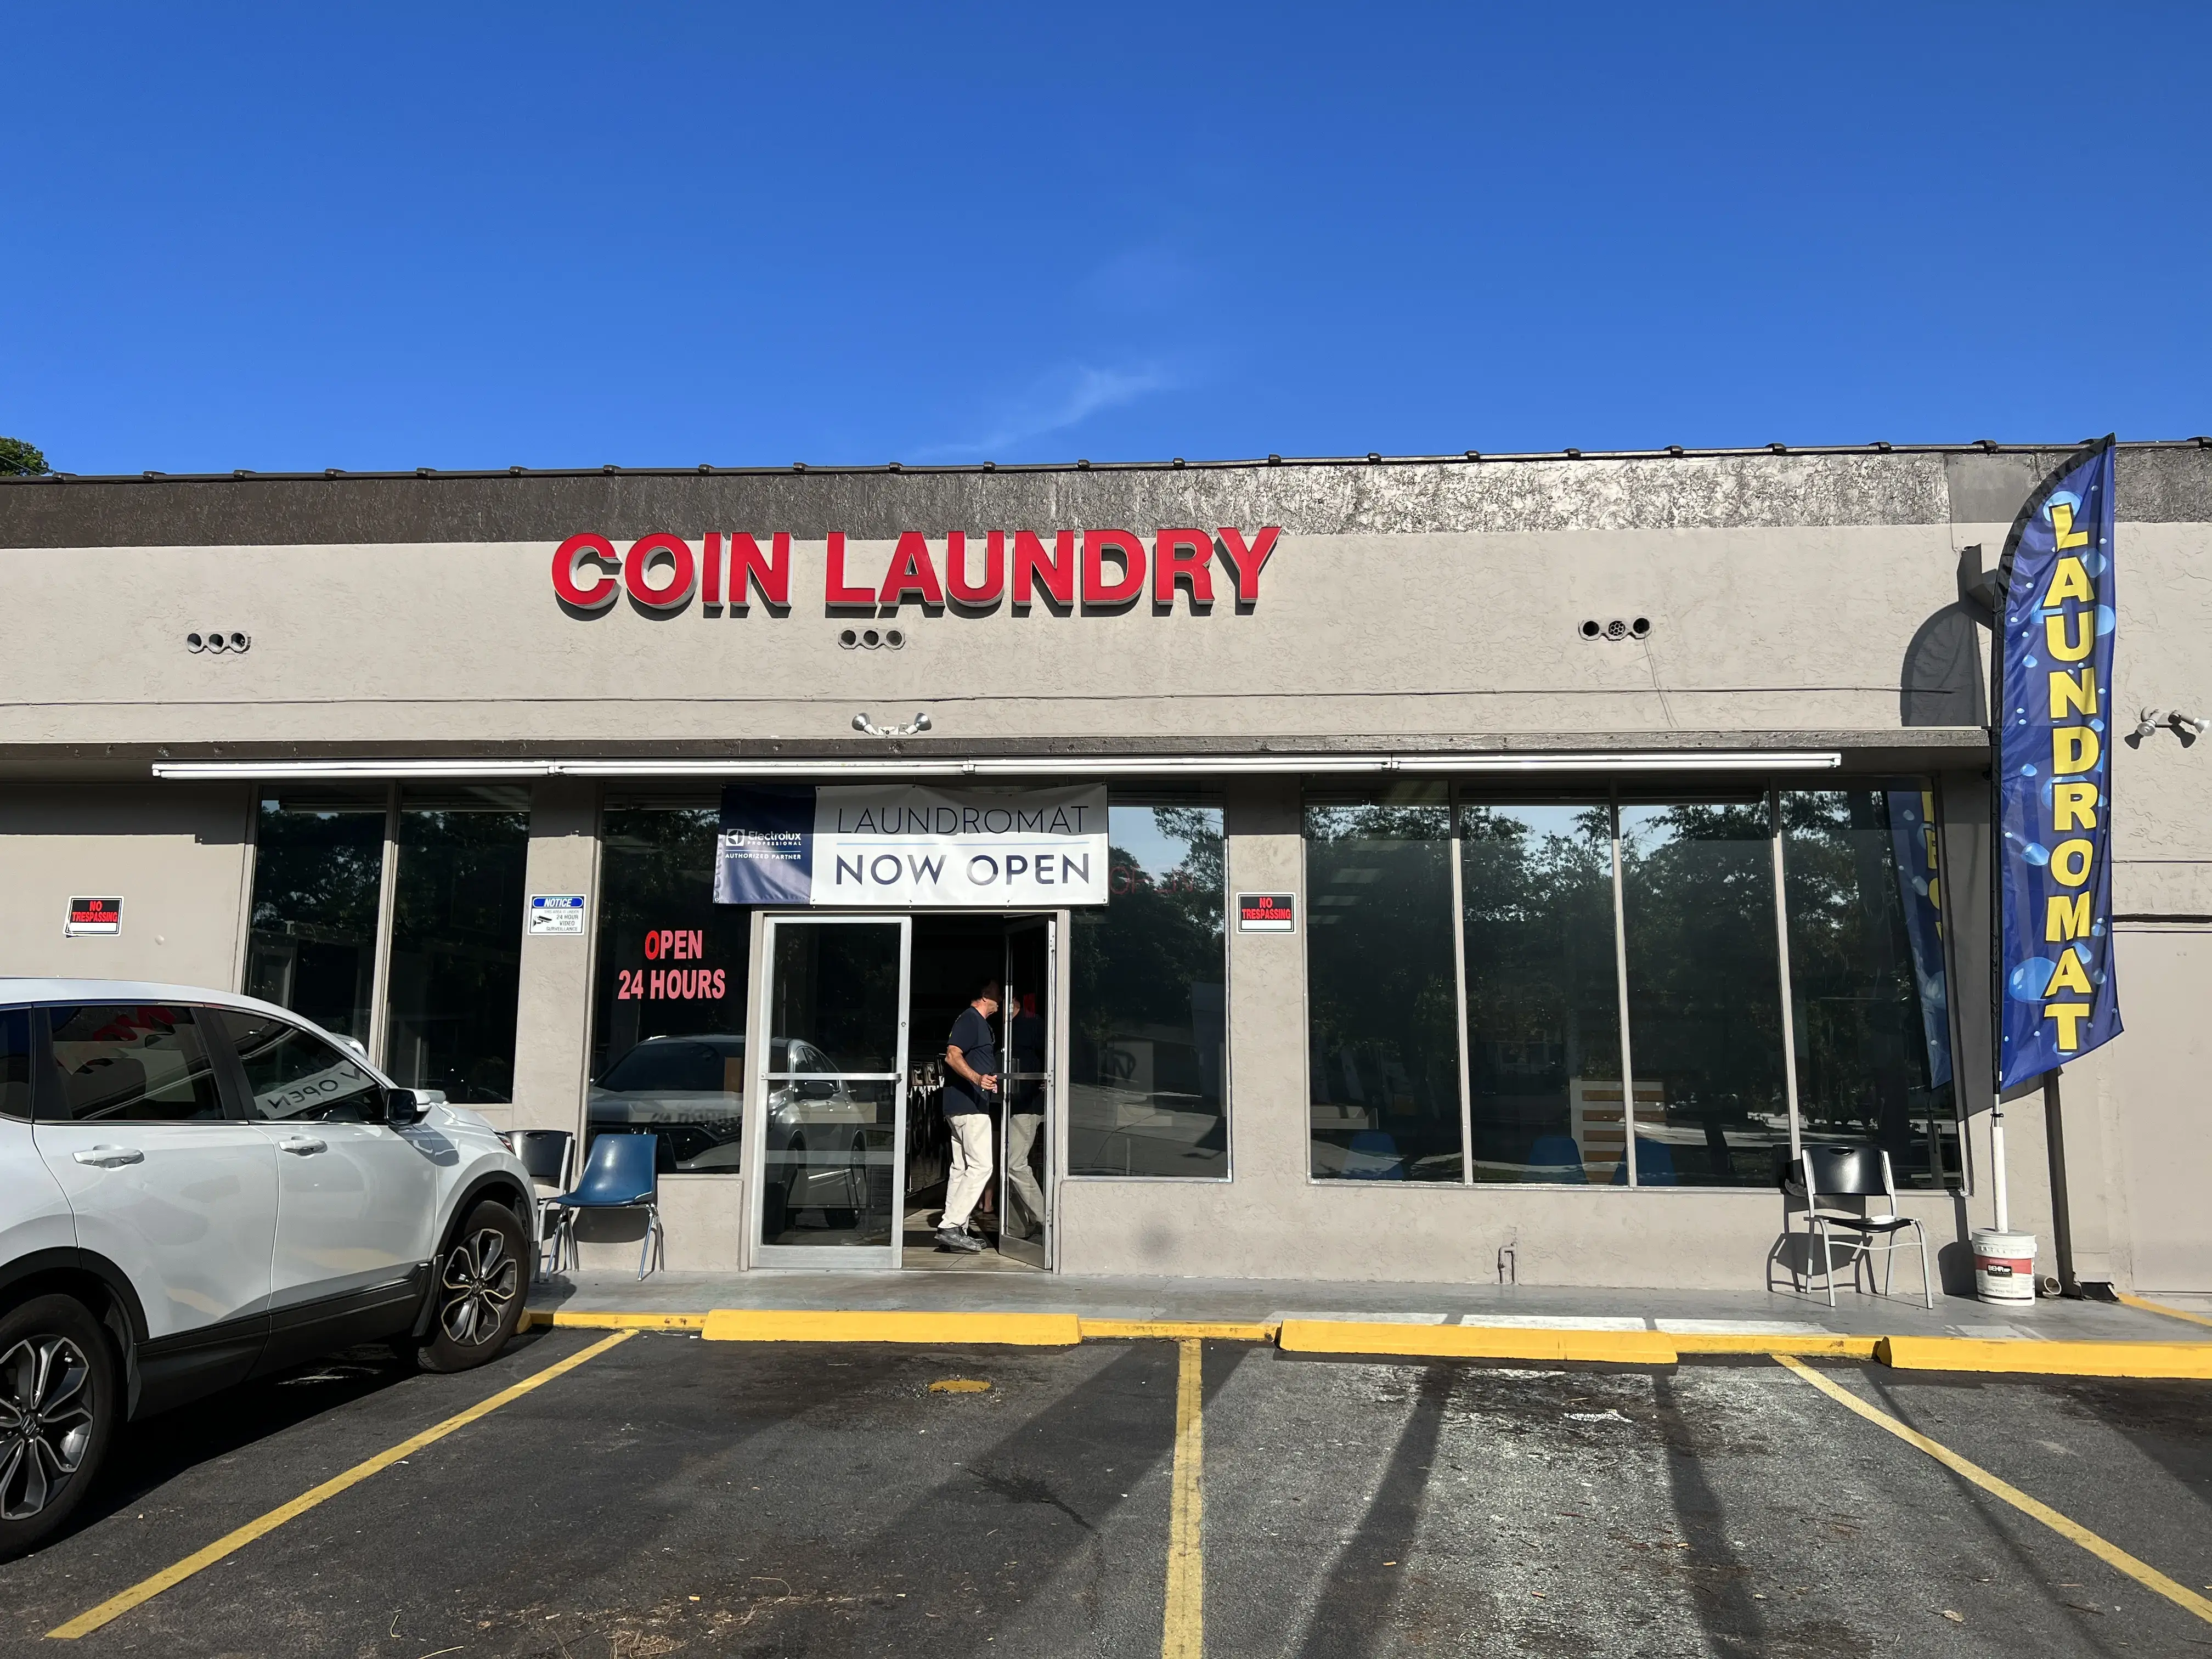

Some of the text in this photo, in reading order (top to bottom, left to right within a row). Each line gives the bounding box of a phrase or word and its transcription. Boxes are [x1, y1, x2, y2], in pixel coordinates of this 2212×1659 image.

[551, 527, 1282, 610] COIN LAUNDRY
[2042, 502, 2102, 1052] LAUNDROMAT
[837, 805, 1089, 834] LAUNDROMAT
[748, 831, 802, 840] Electrolux
[836, 853, 1089, 886] NOW OPEN
[89, 901, 103, 911] NO
[544, 898, 572, 907] NOTICE
[1259, 897, 1273, 908] NO
[72, 912, 117, 922] TRESPASSING
[1242, 909, 1291, 919] TRESPASSING
[645, 930, 702, 960] OPEN
[618, 969, 725, 1000] 24 HOURS
